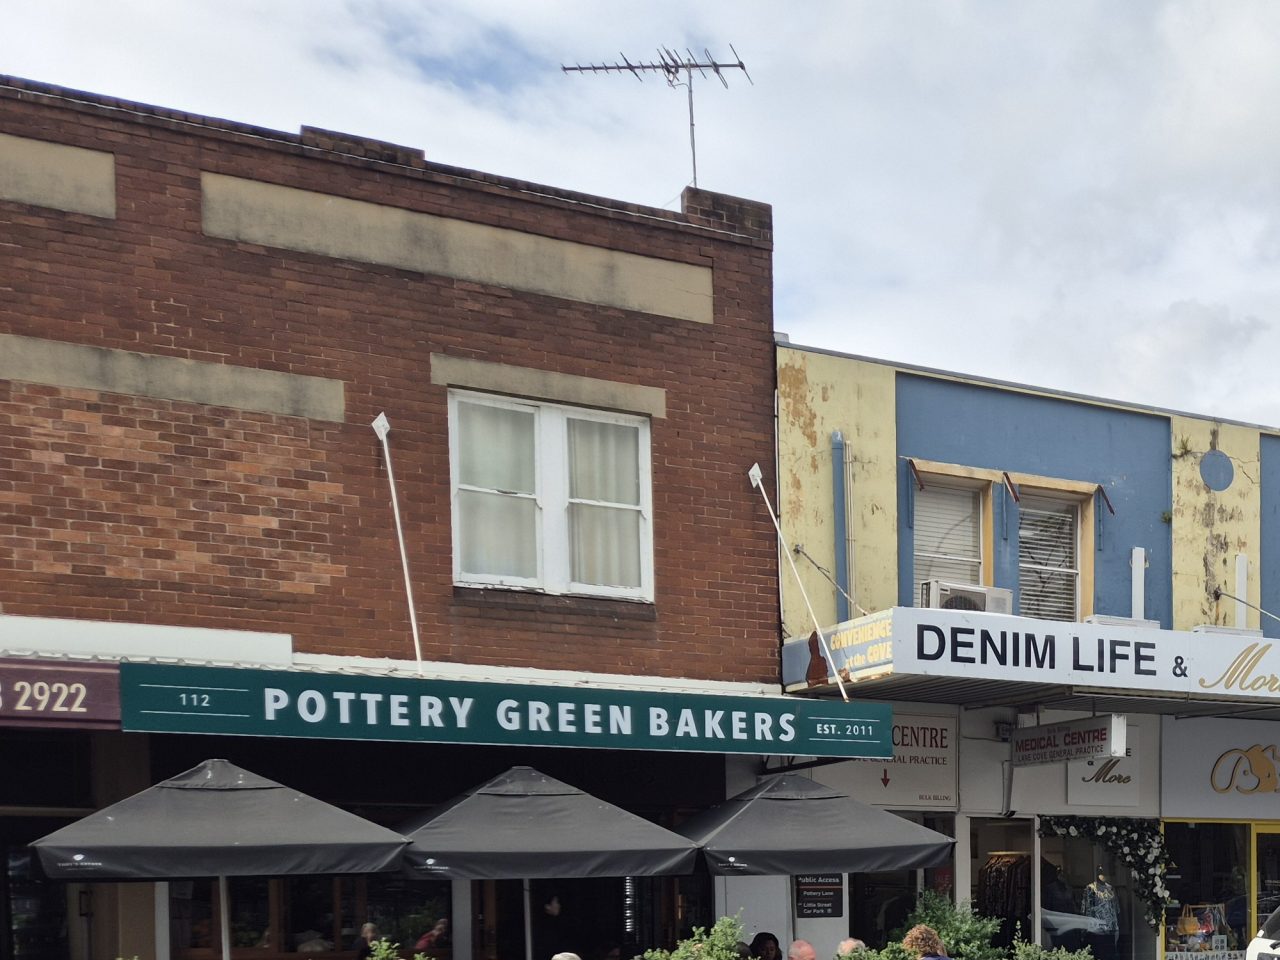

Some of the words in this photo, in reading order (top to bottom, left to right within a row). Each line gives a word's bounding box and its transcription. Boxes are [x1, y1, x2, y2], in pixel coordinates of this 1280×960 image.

[867, 641, 893, 663] COVE
[916, 623, 1056, 670] DENIM
[1072, 636, 1157, 676] LIFE
[1172, 655, 1188, 678] &
[13, 681, 88, 713] 2922
[178, 693, 211, 707] 112
[264, 687, 475, 728] POTTERY
[496, 698, 633, 735] GREEN
[648, 706, 797, 743] BAKERS
[816, 723, 841, 736] EST.
[845, 723, 874, 736] 2011
[891, 724, 949, 749] CENTRE
[1015, 735, 1060, 753] MEDICAL
[1063, 727, 1108, 747] CENTRE
[909, 755, 948, 766] PRACTICE
[1075, 744, 1104, 755] PRACTICE
[1082, 758, 1132, 784] More
